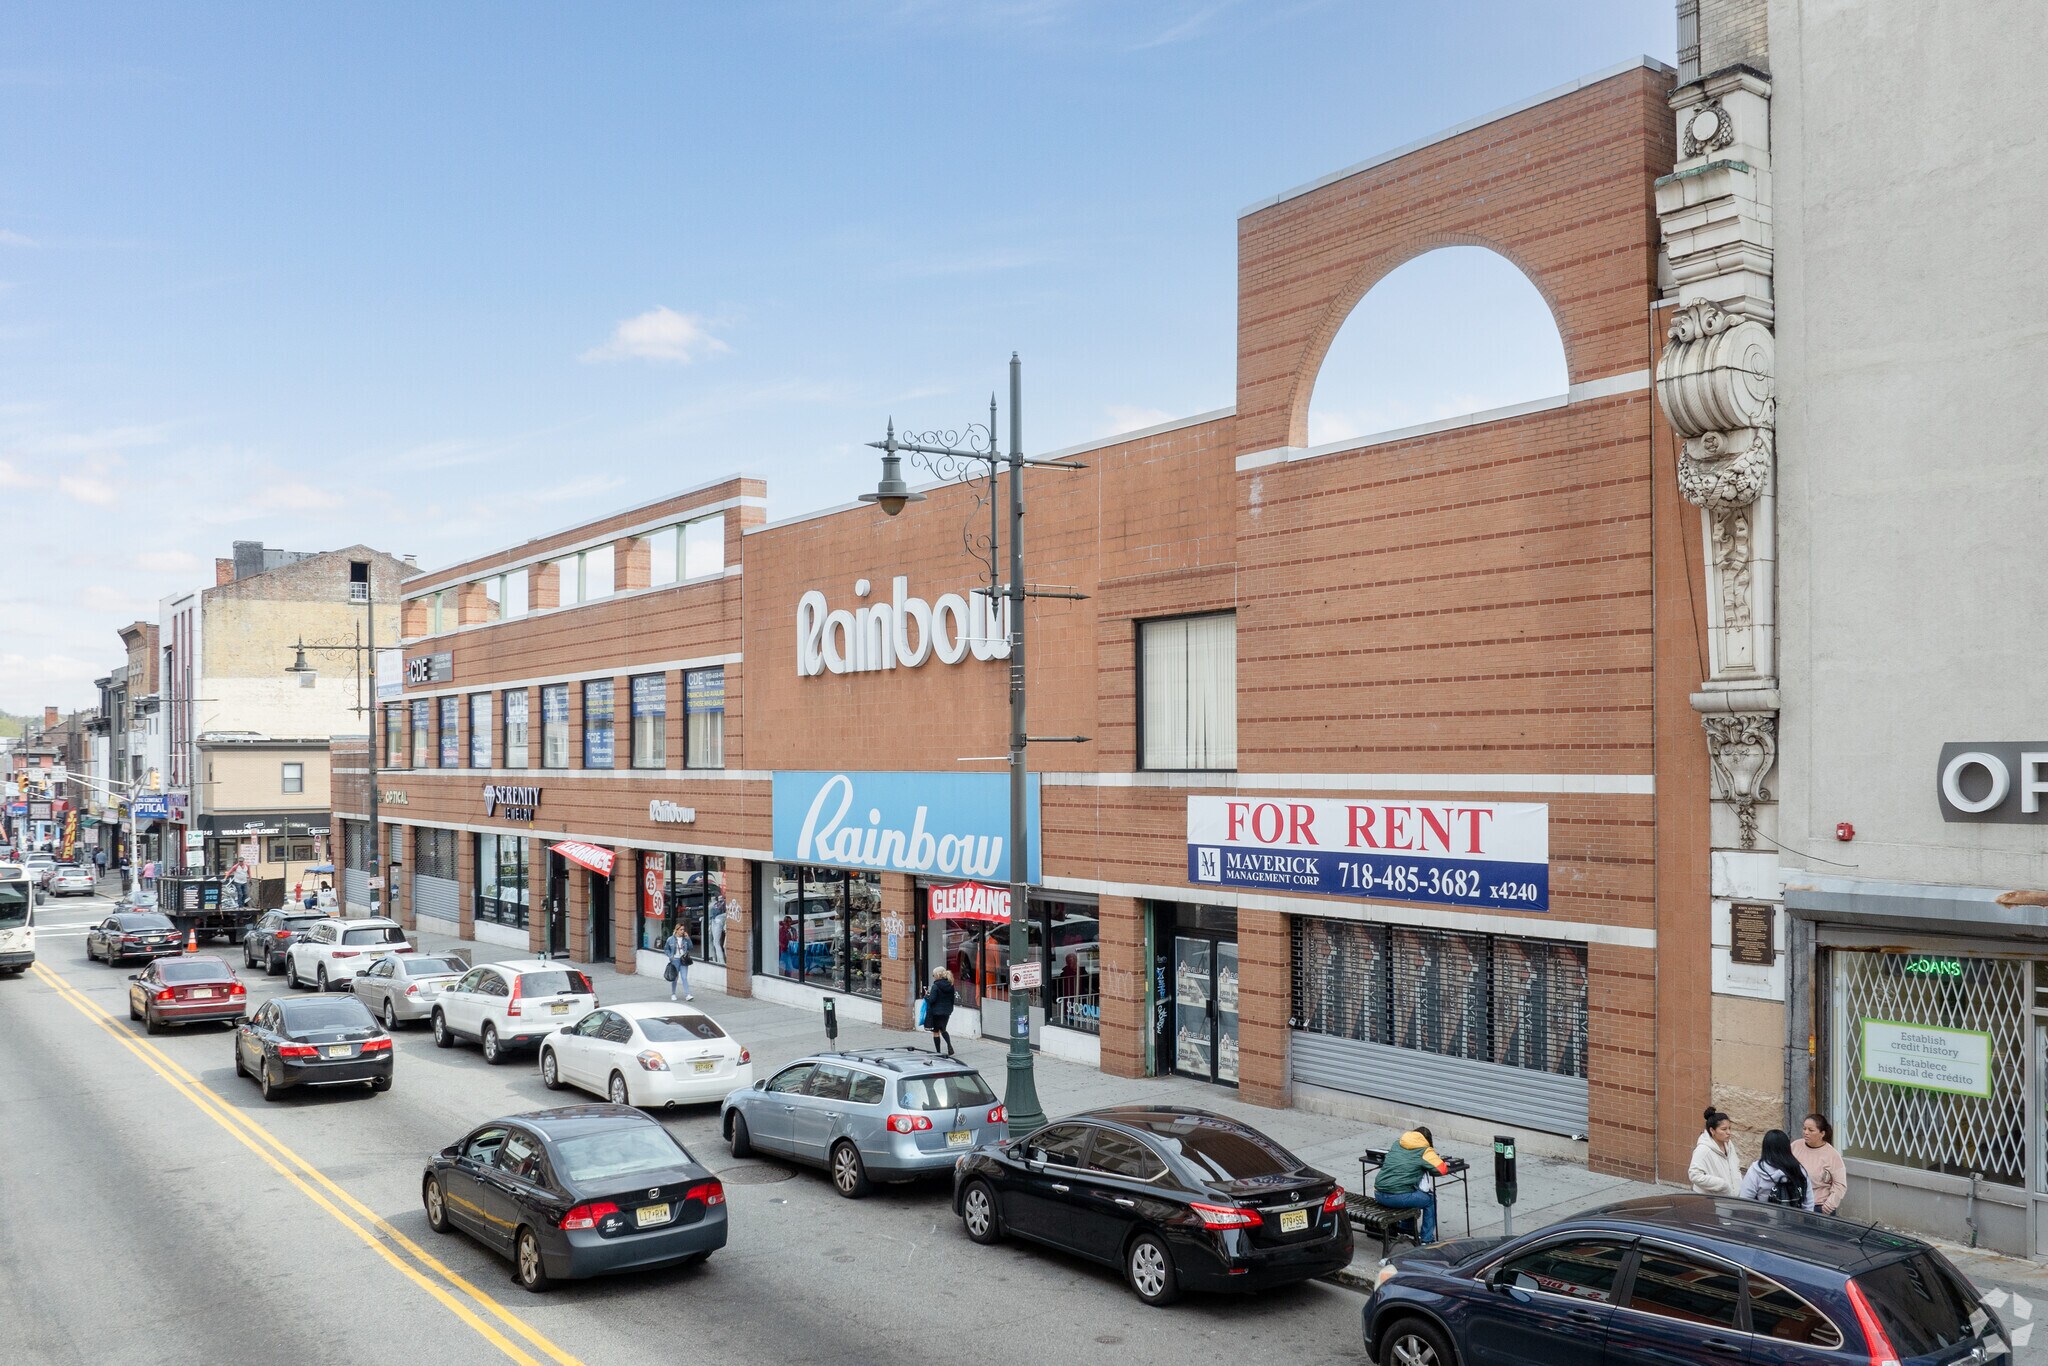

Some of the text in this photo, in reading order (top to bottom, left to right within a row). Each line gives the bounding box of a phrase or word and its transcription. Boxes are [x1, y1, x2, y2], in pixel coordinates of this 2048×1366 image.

[797, 576, 1011, 676] Rainbow
[410, 659, 428, 683] CDE
[688, 672, 704, 686] CDE
[386, 791, 408, 805] OPTICAL
[496, 786, 540, 806] SERENITY
[504, 808, 532, 822] JEWELRY
[650, 800, 695, 824] Rainbow
[62, 810, 77, 859] SALE
[797, 774, 1003, 877] Rainbow
[1225, 802, 1494, 854] FOR RENT
[645, 856, 664, 871] SALE
[1226, 853, 1320, 875] MAVERICK
[1226, 870, 1320, 886] MANAGEMENT CORP
[1338, 862, 1538, 901] 718-485-3682 x4240
[932, 888, 1011, 917] CLEARANC
[1901, 1032, 1946, 1046] Establish
[1891, 1041, 1959, 1059] credit history
[1878, 1064, 1973, 1085] historial de crédito
[1900, 1057, 1947, 1072] Establece
